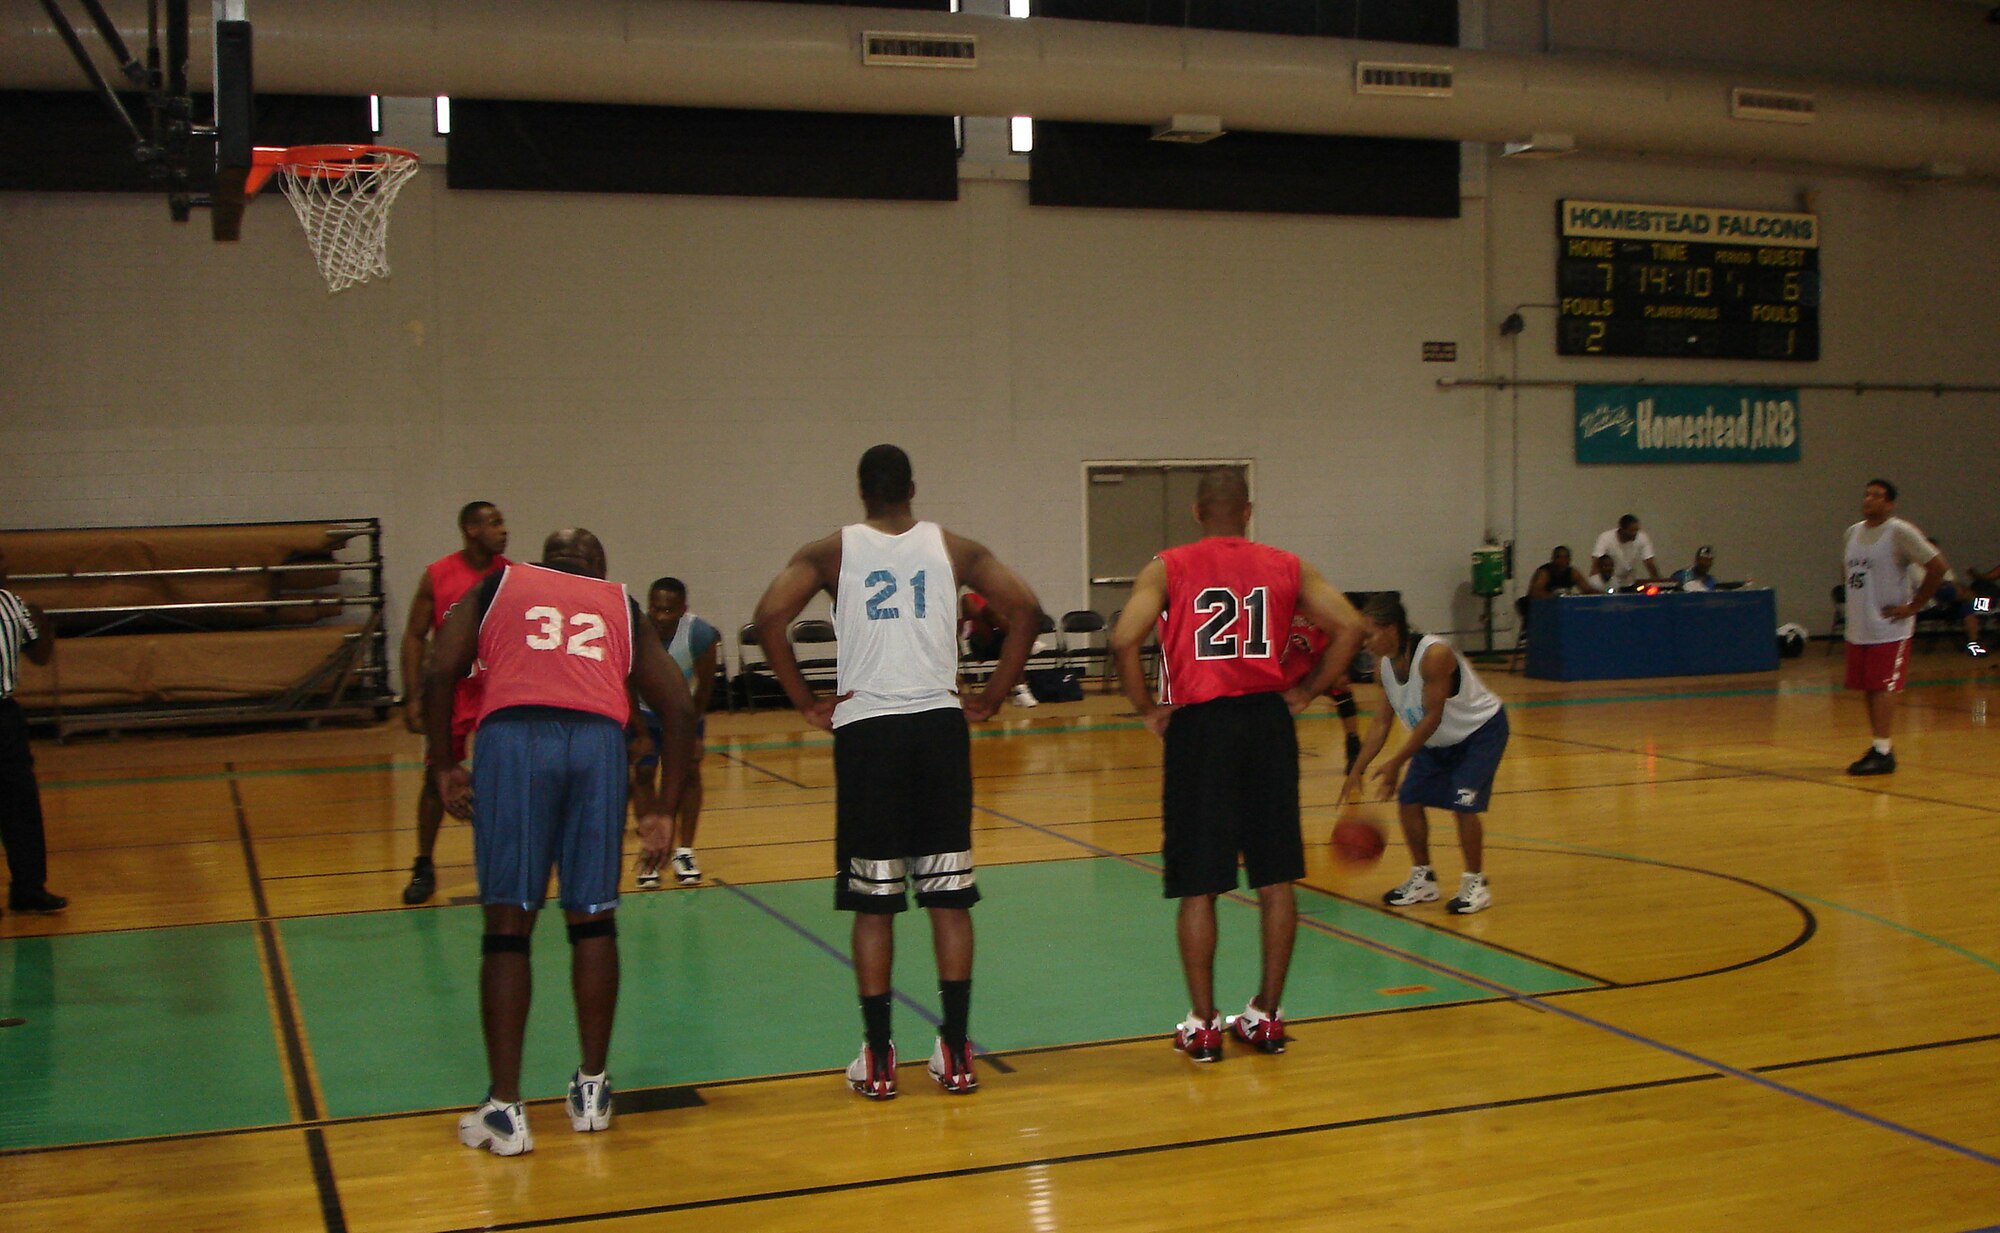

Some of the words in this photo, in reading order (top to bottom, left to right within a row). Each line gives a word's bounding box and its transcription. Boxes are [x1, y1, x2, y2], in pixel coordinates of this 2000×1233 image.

[1570, 207, 1711, 233] HOMESTEAD
[1716, 215, 1814, 240] FALCONS
[1568, 239, 1615, 258] HOME
[1651, 242, 1689, 261] TIME
[1757, 248, 1806, 266] GUEST
[1596, 262, 1614, 292] 7
[1638, 266, 1713, 298] 14:10
[1783, 271, 1801, 302] 6
[1561, 296, 1614, 316] FOULS
[1751, 304, 1801, 323] FOULS
[1585, 320, 1607, 352] 2
[1637, 398, 1749, 449] Homestead
[865, 569, 926, 620] 21
[525, 606, 606, 662] 32
[1194, 587, 1271, 660] 21
